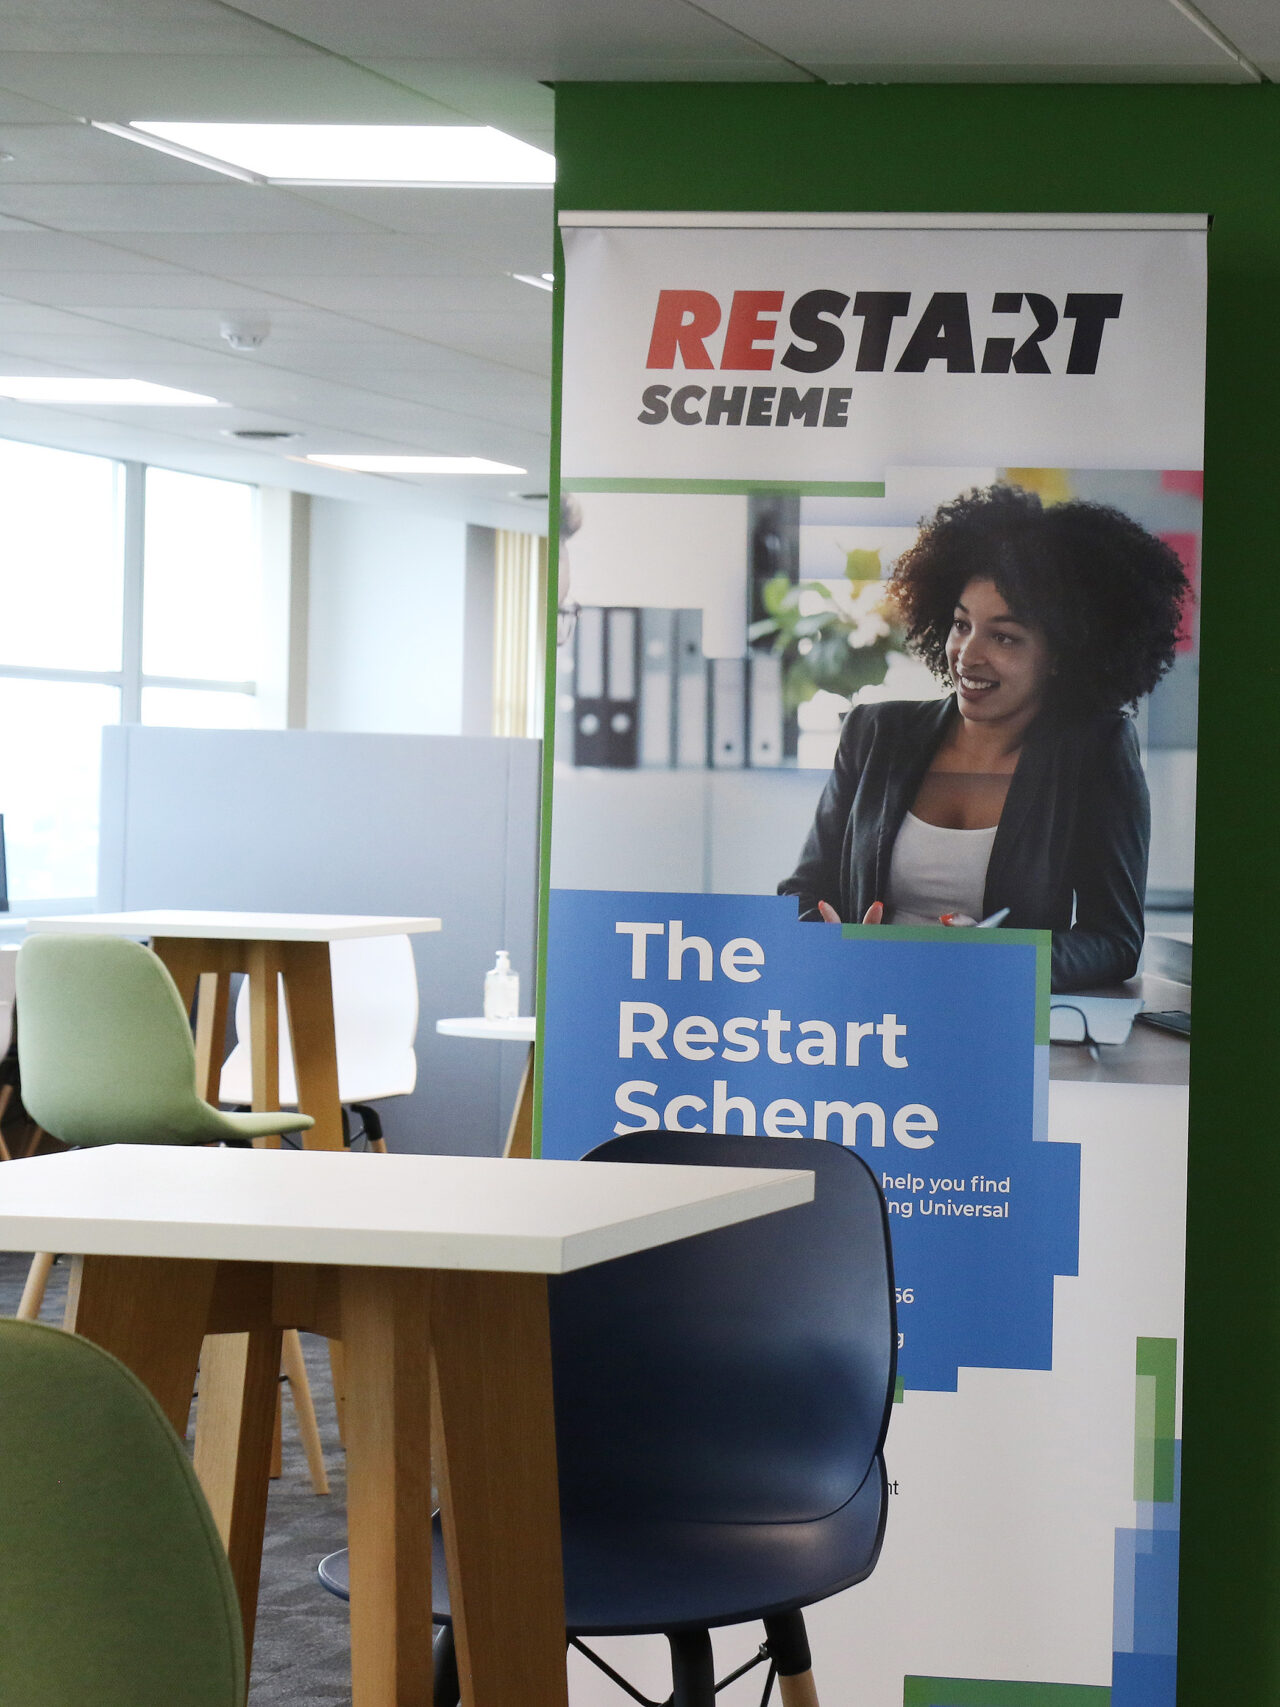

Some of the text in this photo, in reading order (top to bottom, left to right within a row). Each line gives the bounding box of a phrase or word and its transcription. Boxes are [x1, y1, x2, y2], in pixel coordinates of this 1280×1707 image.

[645, 289, 1124, 375] RESTART
[637, 384, 853, 428] SCHEME
[615, 919, 765, 983] The
[618, 1001, 909, 1069] Restart
[613, 1079, 939, 1150] Scheme
[882, 1172, 1010, 1195] help you find
[885, 1197, 1009, 1218] ng Universal
